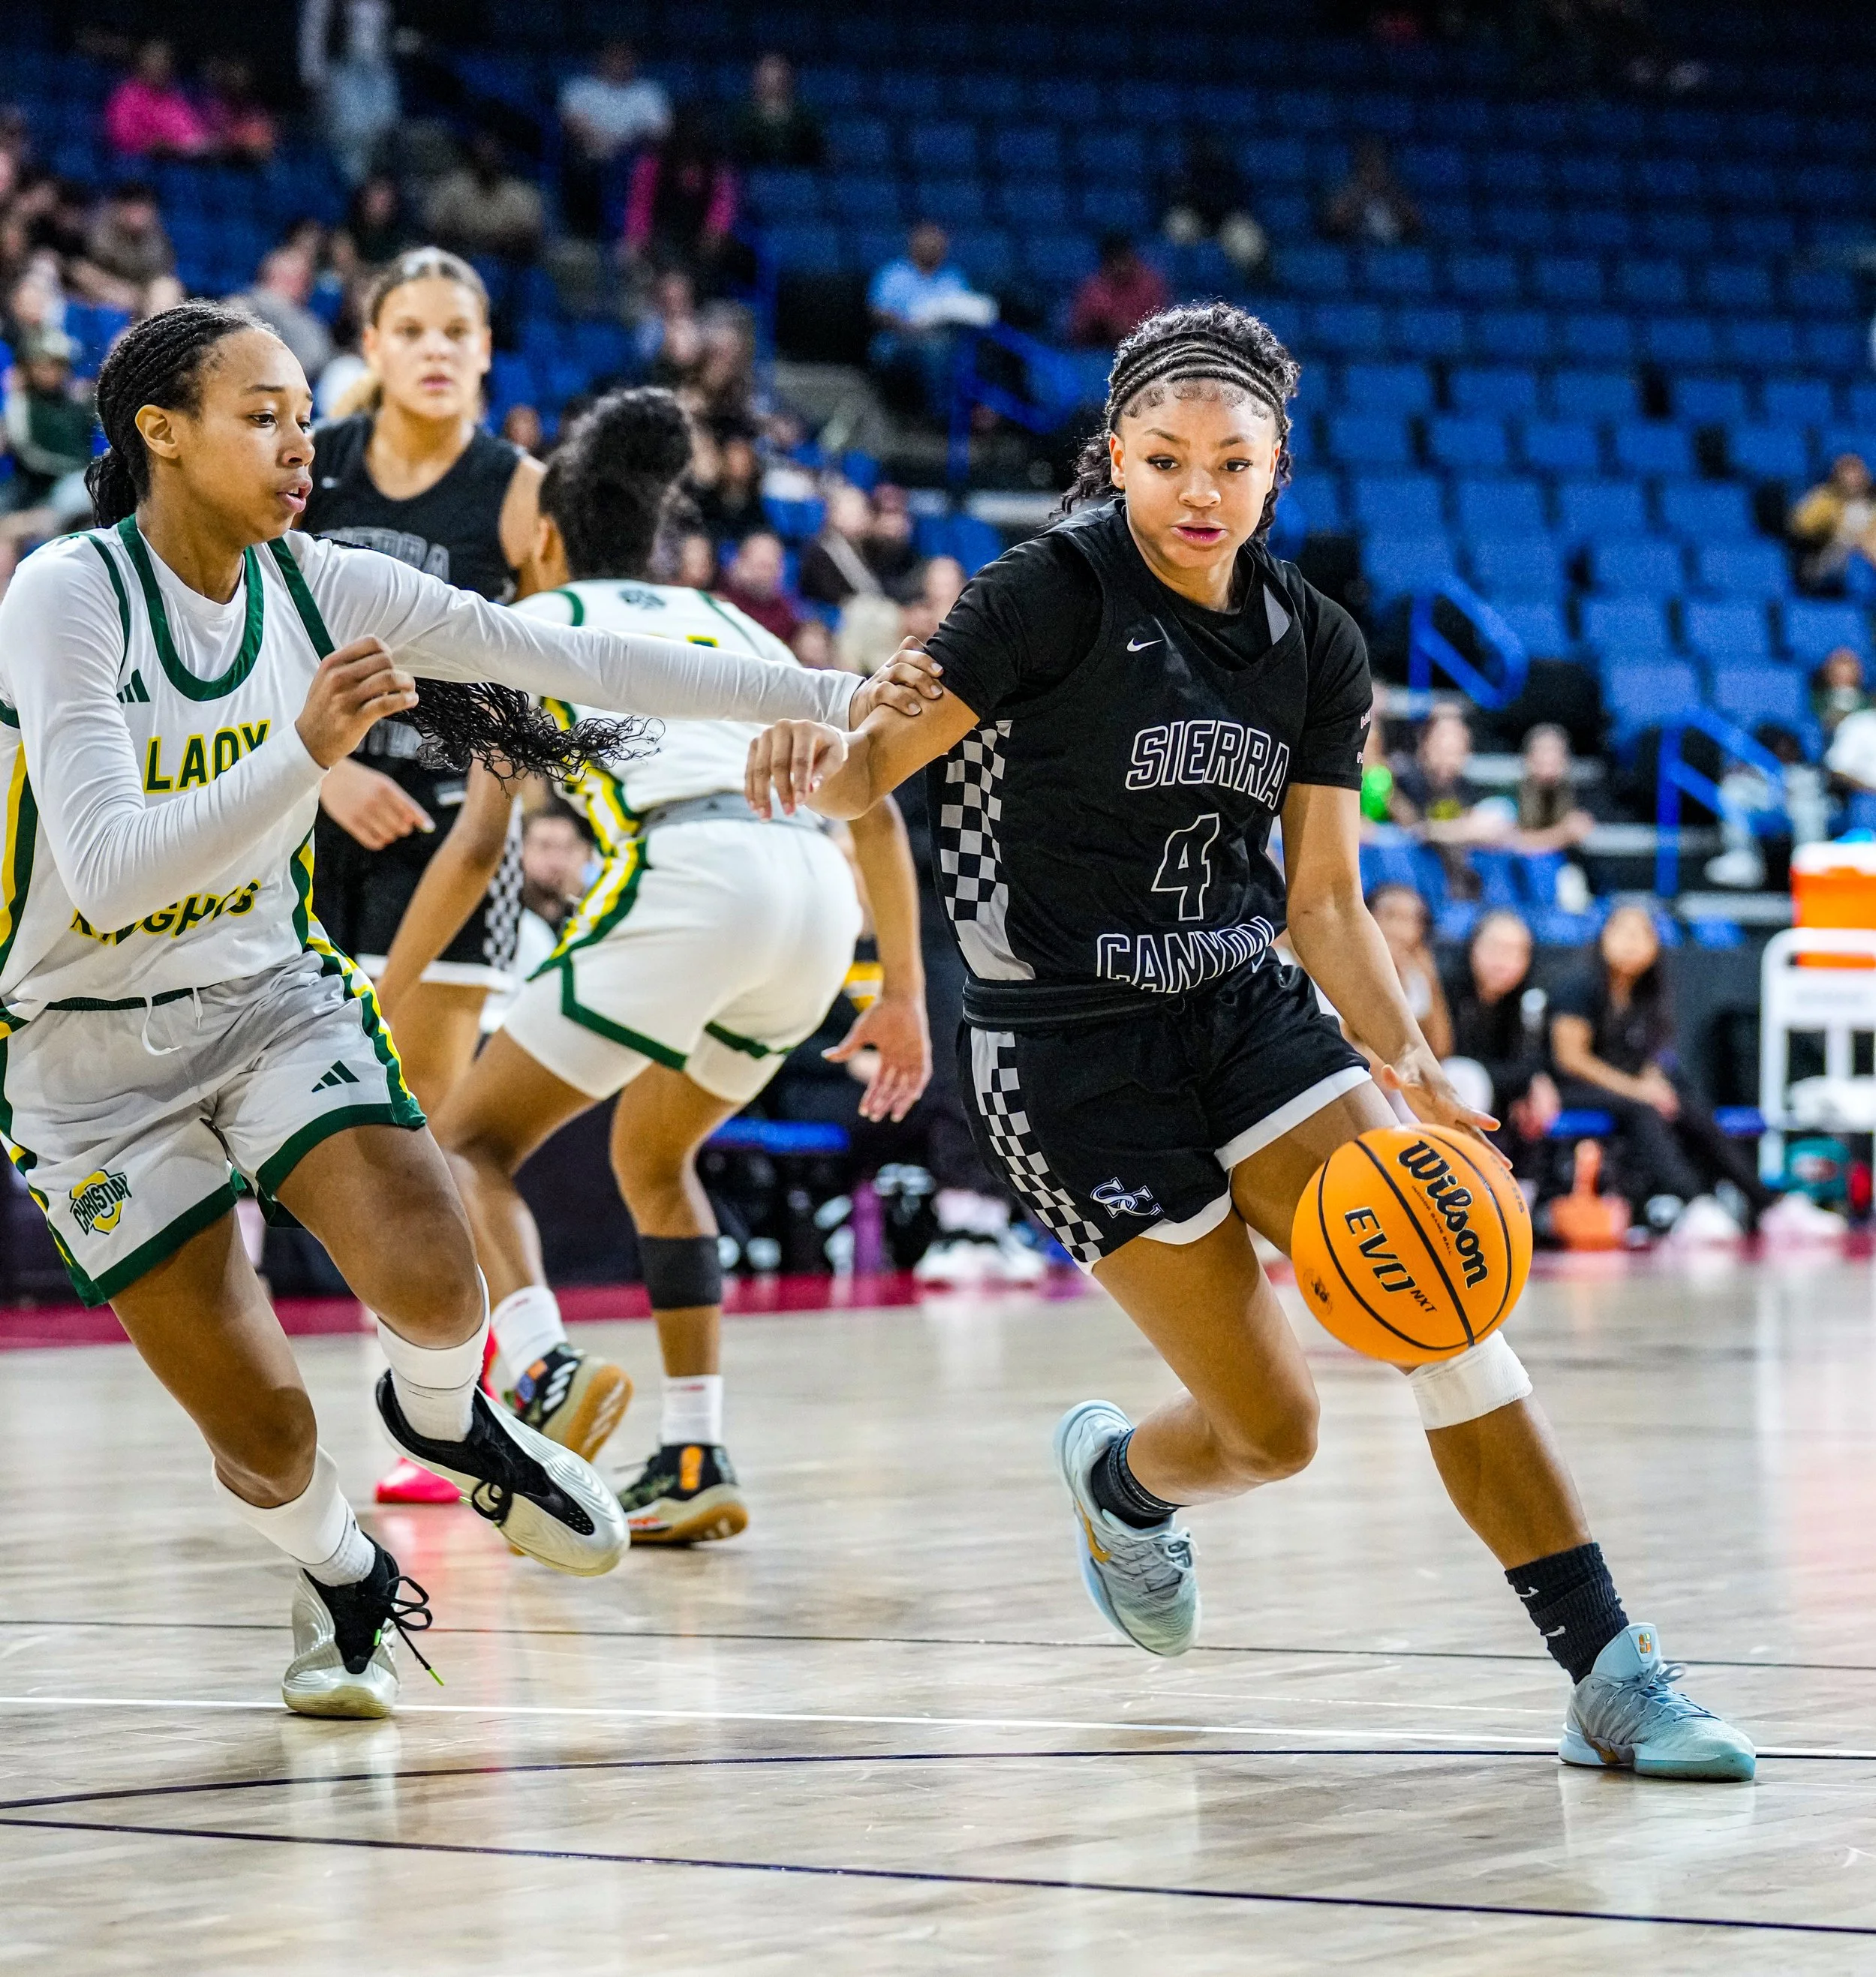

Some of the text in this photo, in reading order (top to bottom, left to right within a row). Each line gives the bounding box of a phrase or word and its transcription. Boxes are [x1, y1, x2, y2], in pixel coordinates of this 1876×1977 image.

[143, 719, 271, 794] LADY
[1125, 720, 1290, 811] SIERRA
[1150, 813, 1221, 921] 4
[73, 1173, 133, 1236] CHRISTIAN
[1396, 1139, 1489, 1290] Wilson
[1411, 1185, 1452, 1255] INDOOR GAME BALL
[1344, 1206, 1438, 1313] EVO NXT
